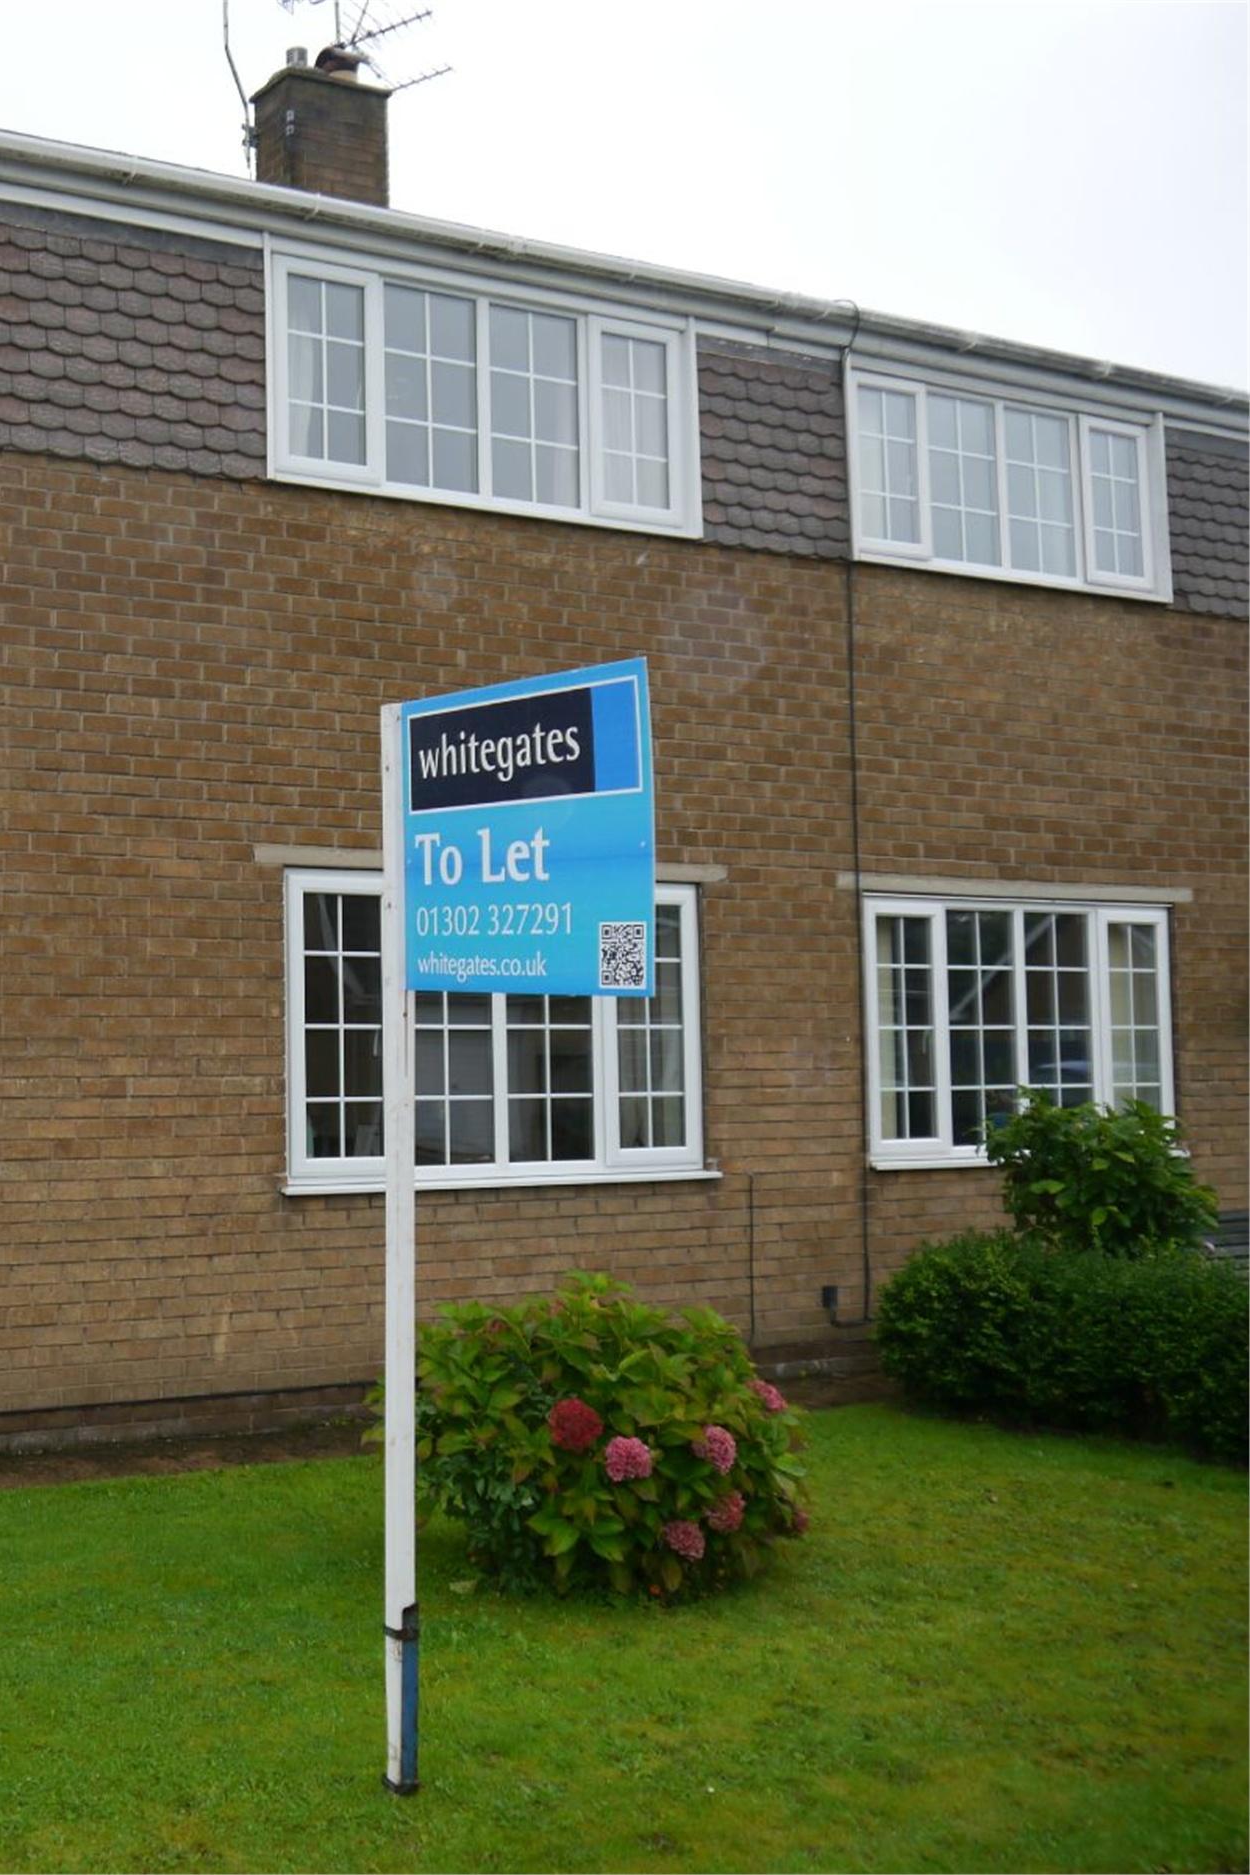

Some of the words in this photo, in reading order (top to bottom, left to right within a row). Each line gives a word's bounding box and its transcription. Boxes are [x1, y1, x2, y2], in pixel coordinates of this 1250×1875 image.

[418, 722, 581, 782] whitegates
[414, 832, 463, 886] To
[477, 826, 550, 884] Let
[416, 905, 480, 937] 01302
[487, 902, 573, 936] 327291
[417, 951, 548, 983] whitegates.co.uk
